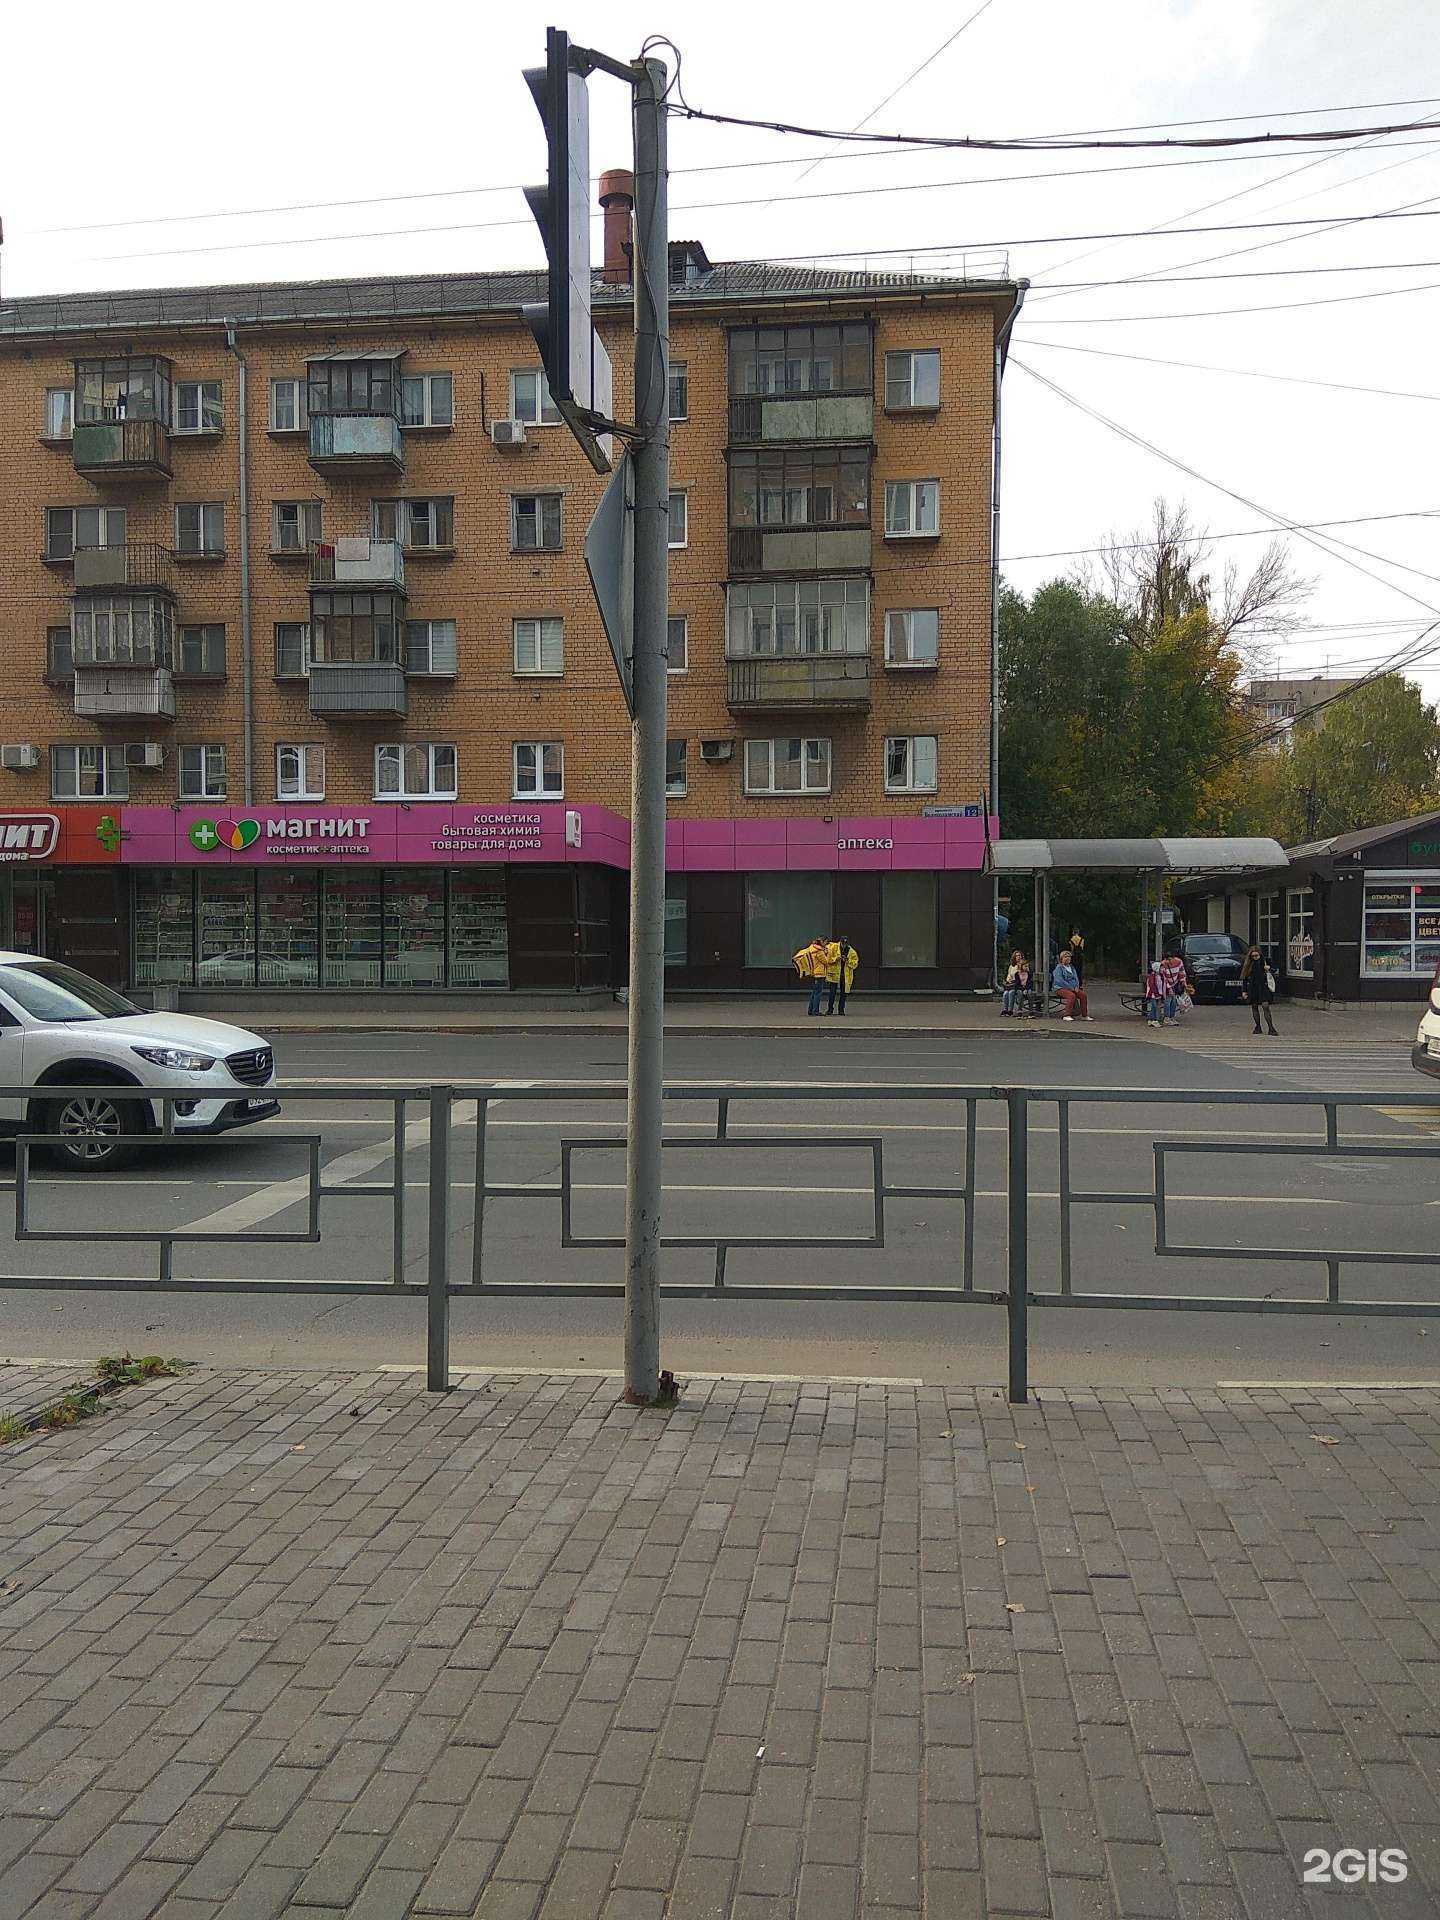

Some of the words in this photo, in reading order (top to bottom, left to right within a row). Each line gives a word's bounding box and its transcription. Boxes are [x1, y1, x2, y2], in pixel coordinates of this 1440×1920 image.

[473, 813, 541, 824] косметика
[266, 818, 370, 838] магнит
[442, 824, 497, 836] бытовая
[500, 825, 540, 836] химия
[0, 824, 49, 848] ИТ
[330, 844, 370, 854] аптека
[431, 840, 478, 851] товары
[480, 839, 505, 851] для
[508, 838, 541, 850] дома
[837, 838, 893, 849] аптека
[1418, 917, 1437, 925] ВСЕ
[1418, 927, 1440, 937] ЦВЕ
